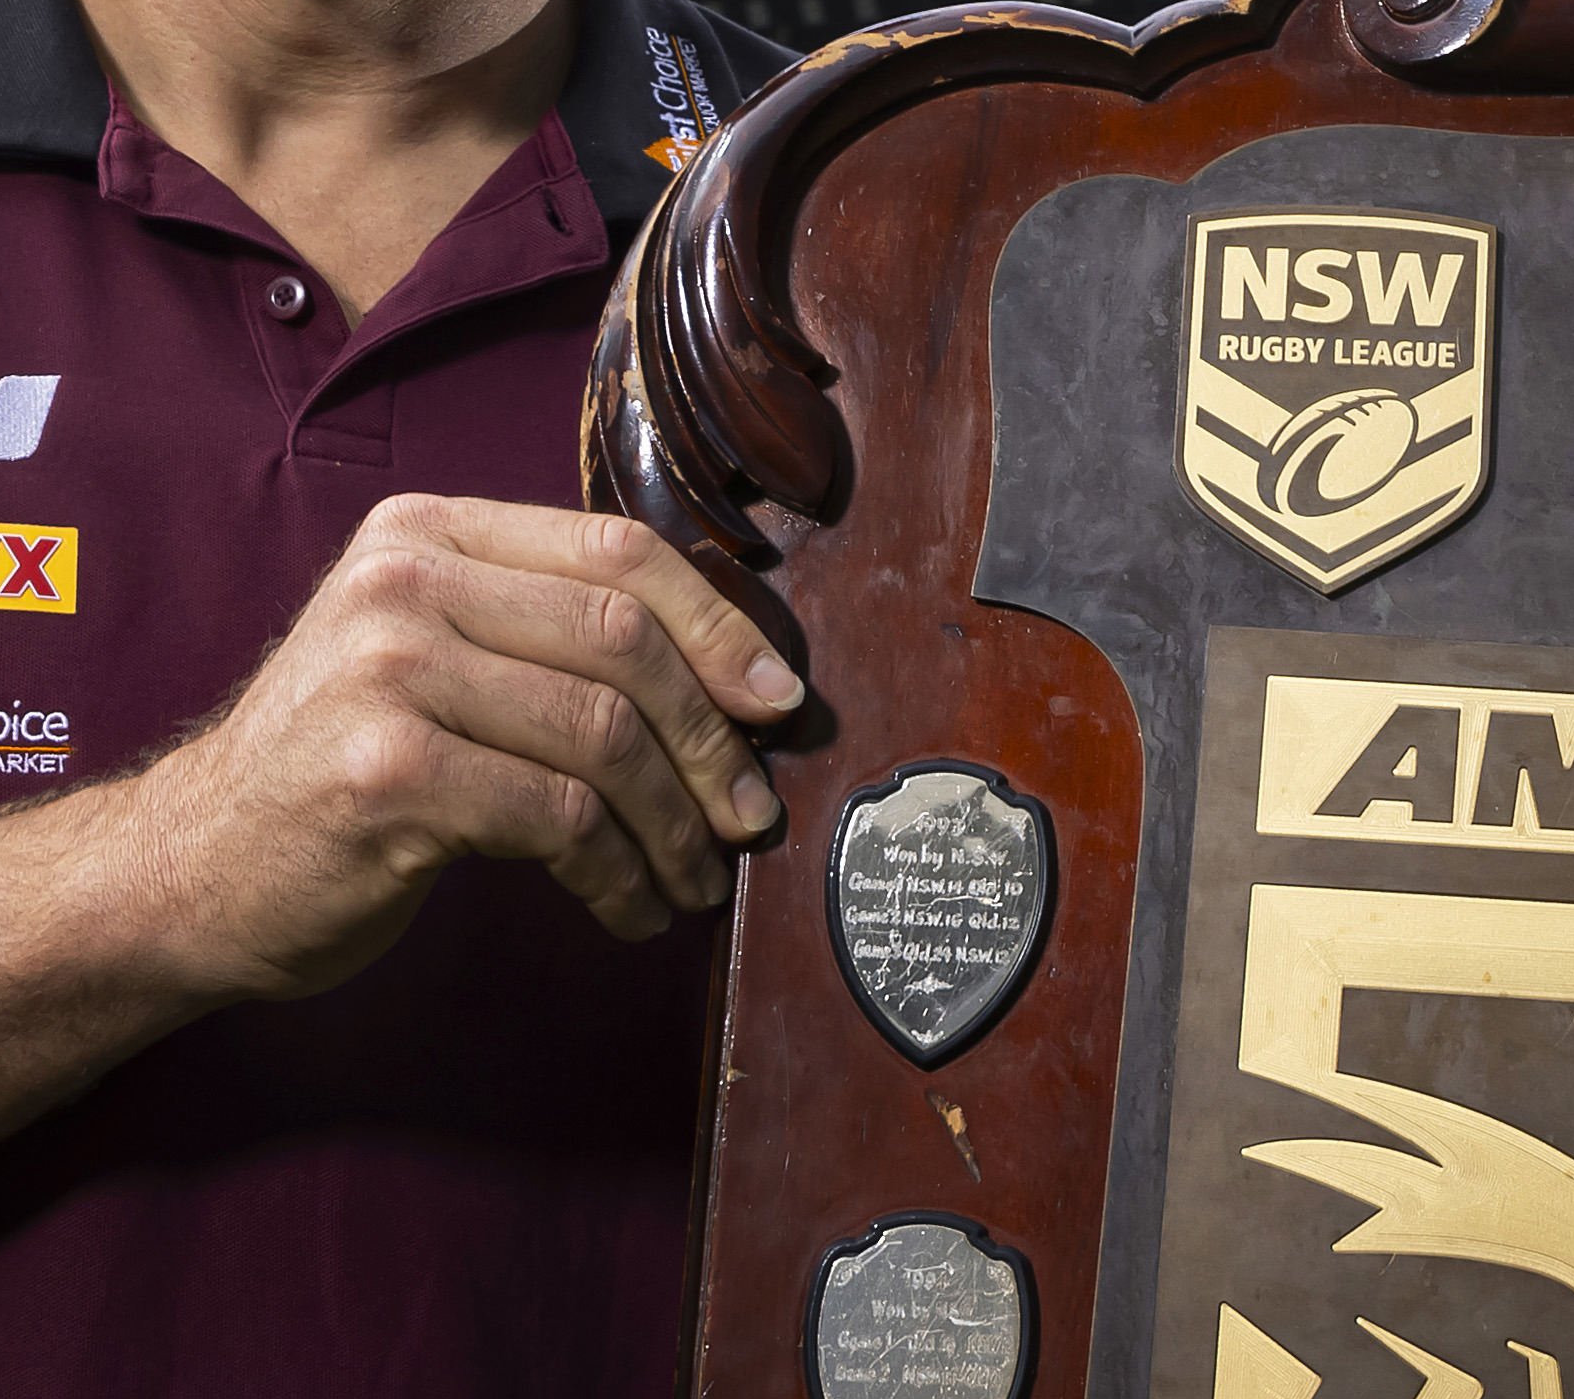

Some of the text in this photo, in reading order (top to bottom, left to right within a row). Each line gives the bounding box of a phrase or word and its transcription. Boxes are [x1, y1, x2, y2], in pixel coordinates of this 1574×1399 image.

[646, 27, 688, 111] Choice
[676, 36, 709, 92] MARKET
[1221, 246, 1464, 327] NSW
[1219, 335, 1456, 368] RUGBY LEAGUE
